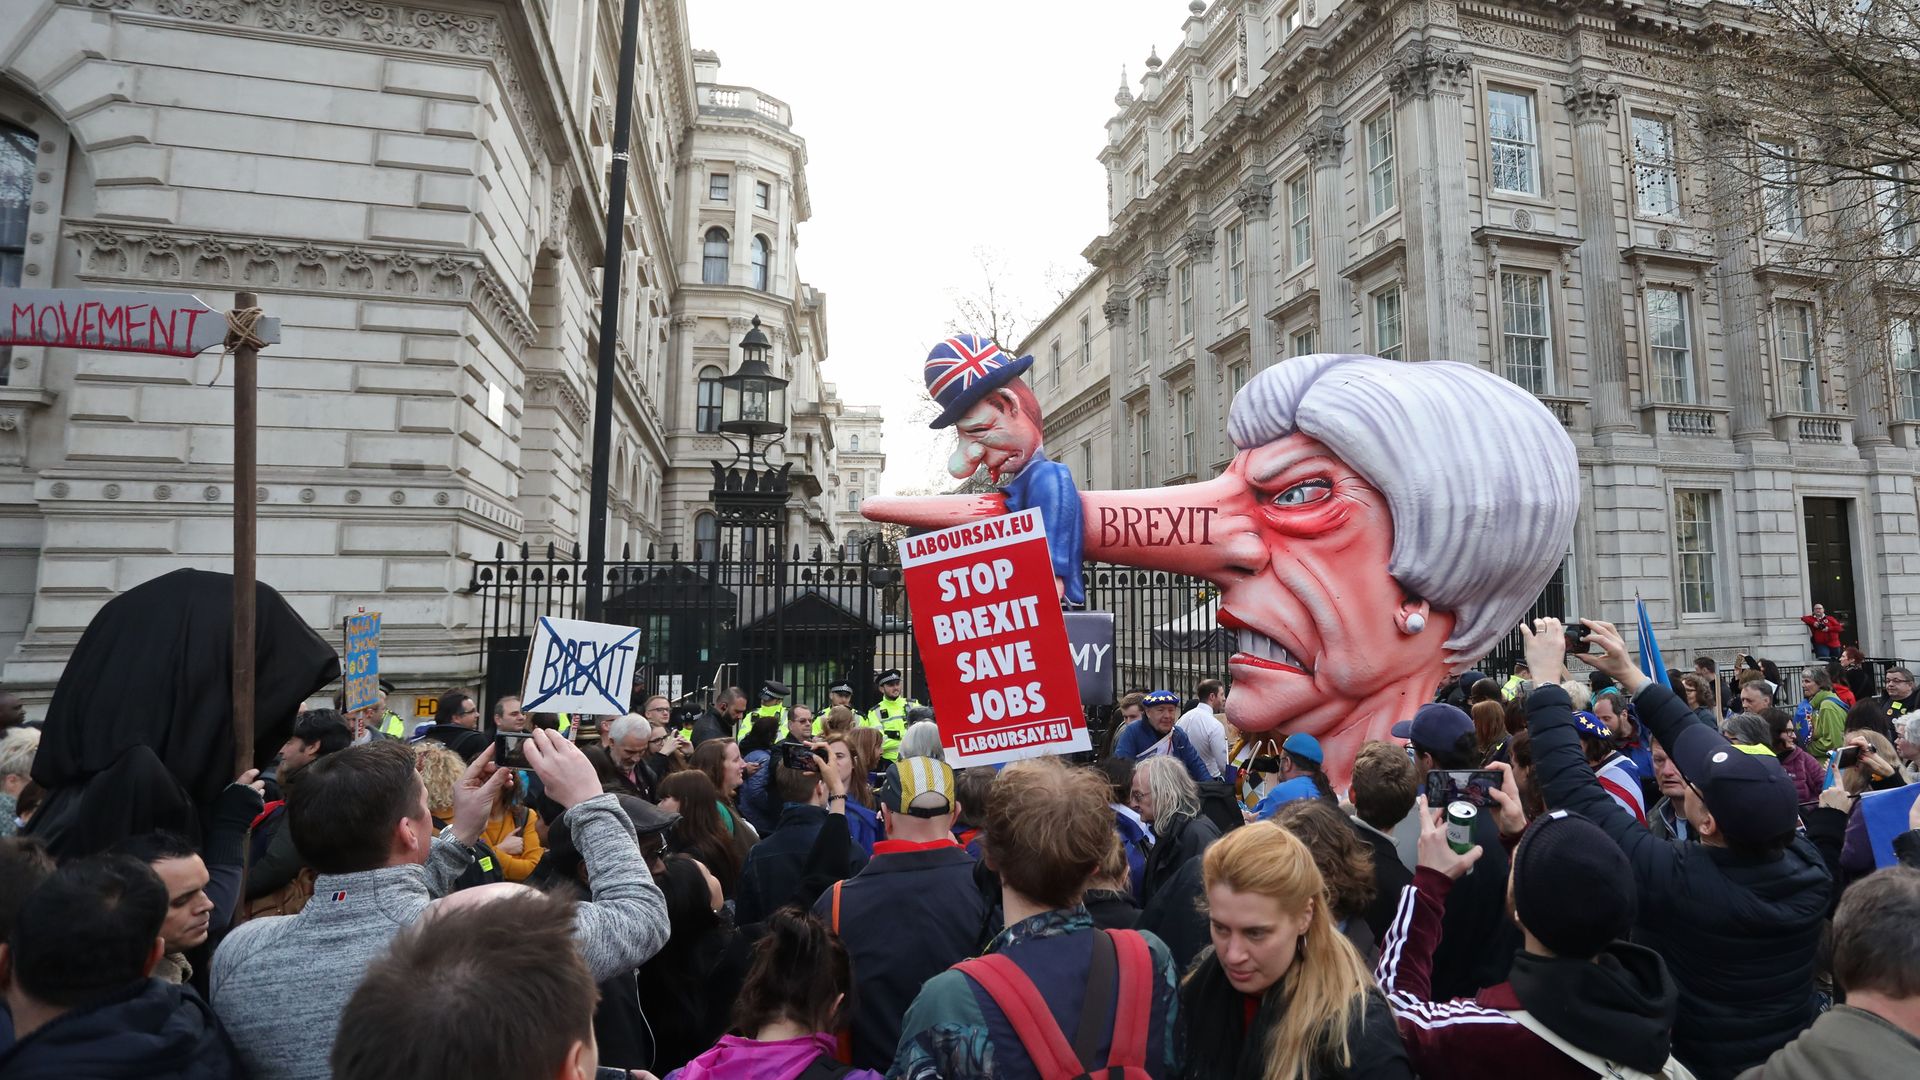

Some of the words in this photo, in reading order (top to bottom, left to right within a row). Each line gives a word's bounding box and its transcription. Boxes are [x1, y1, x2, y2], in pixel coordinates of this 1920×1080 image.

[12, 300, 209, 353] MOVEMENT
[906, 514, 1034, 559] LABOURSAY.EU
[1099, 507, 1218, 547] BREXIT
[937, 558, 1014, 602] STOP
[932, 595, 1040, 646] BREXIT
[357, 653, 370, 674] OF
[539, 637, 634, 697] BREXIT
[956, 640, 1036, 684] SAVE
[967, 682, 1046, 724] JOBS
[959, 723, 1068, 753] LABOURSAY.EU
